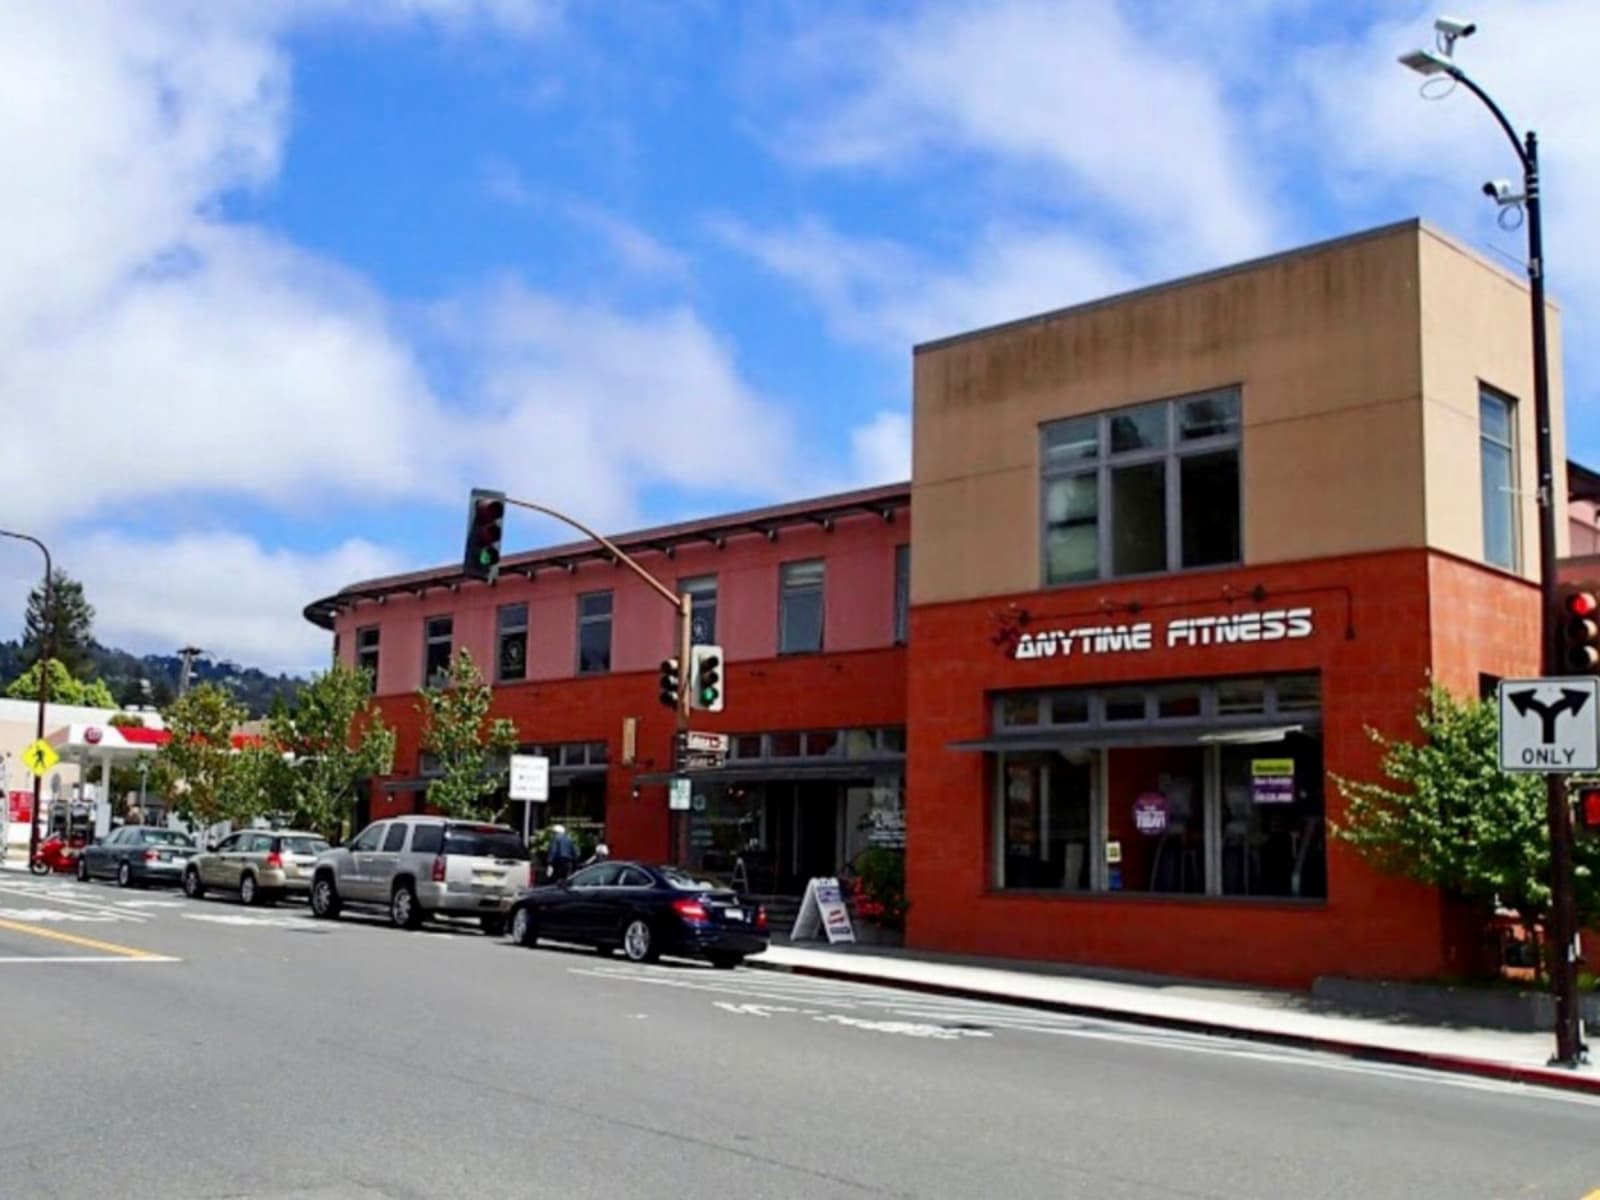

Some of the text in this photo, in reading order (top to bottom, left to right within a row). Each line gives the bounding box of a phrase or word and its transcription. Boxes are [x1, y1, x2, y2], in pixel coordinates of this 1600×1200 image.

[1015, 607, 1313, 659] ANYTIME FITNESS
[1521, 747, 1576, 765] ONLY
